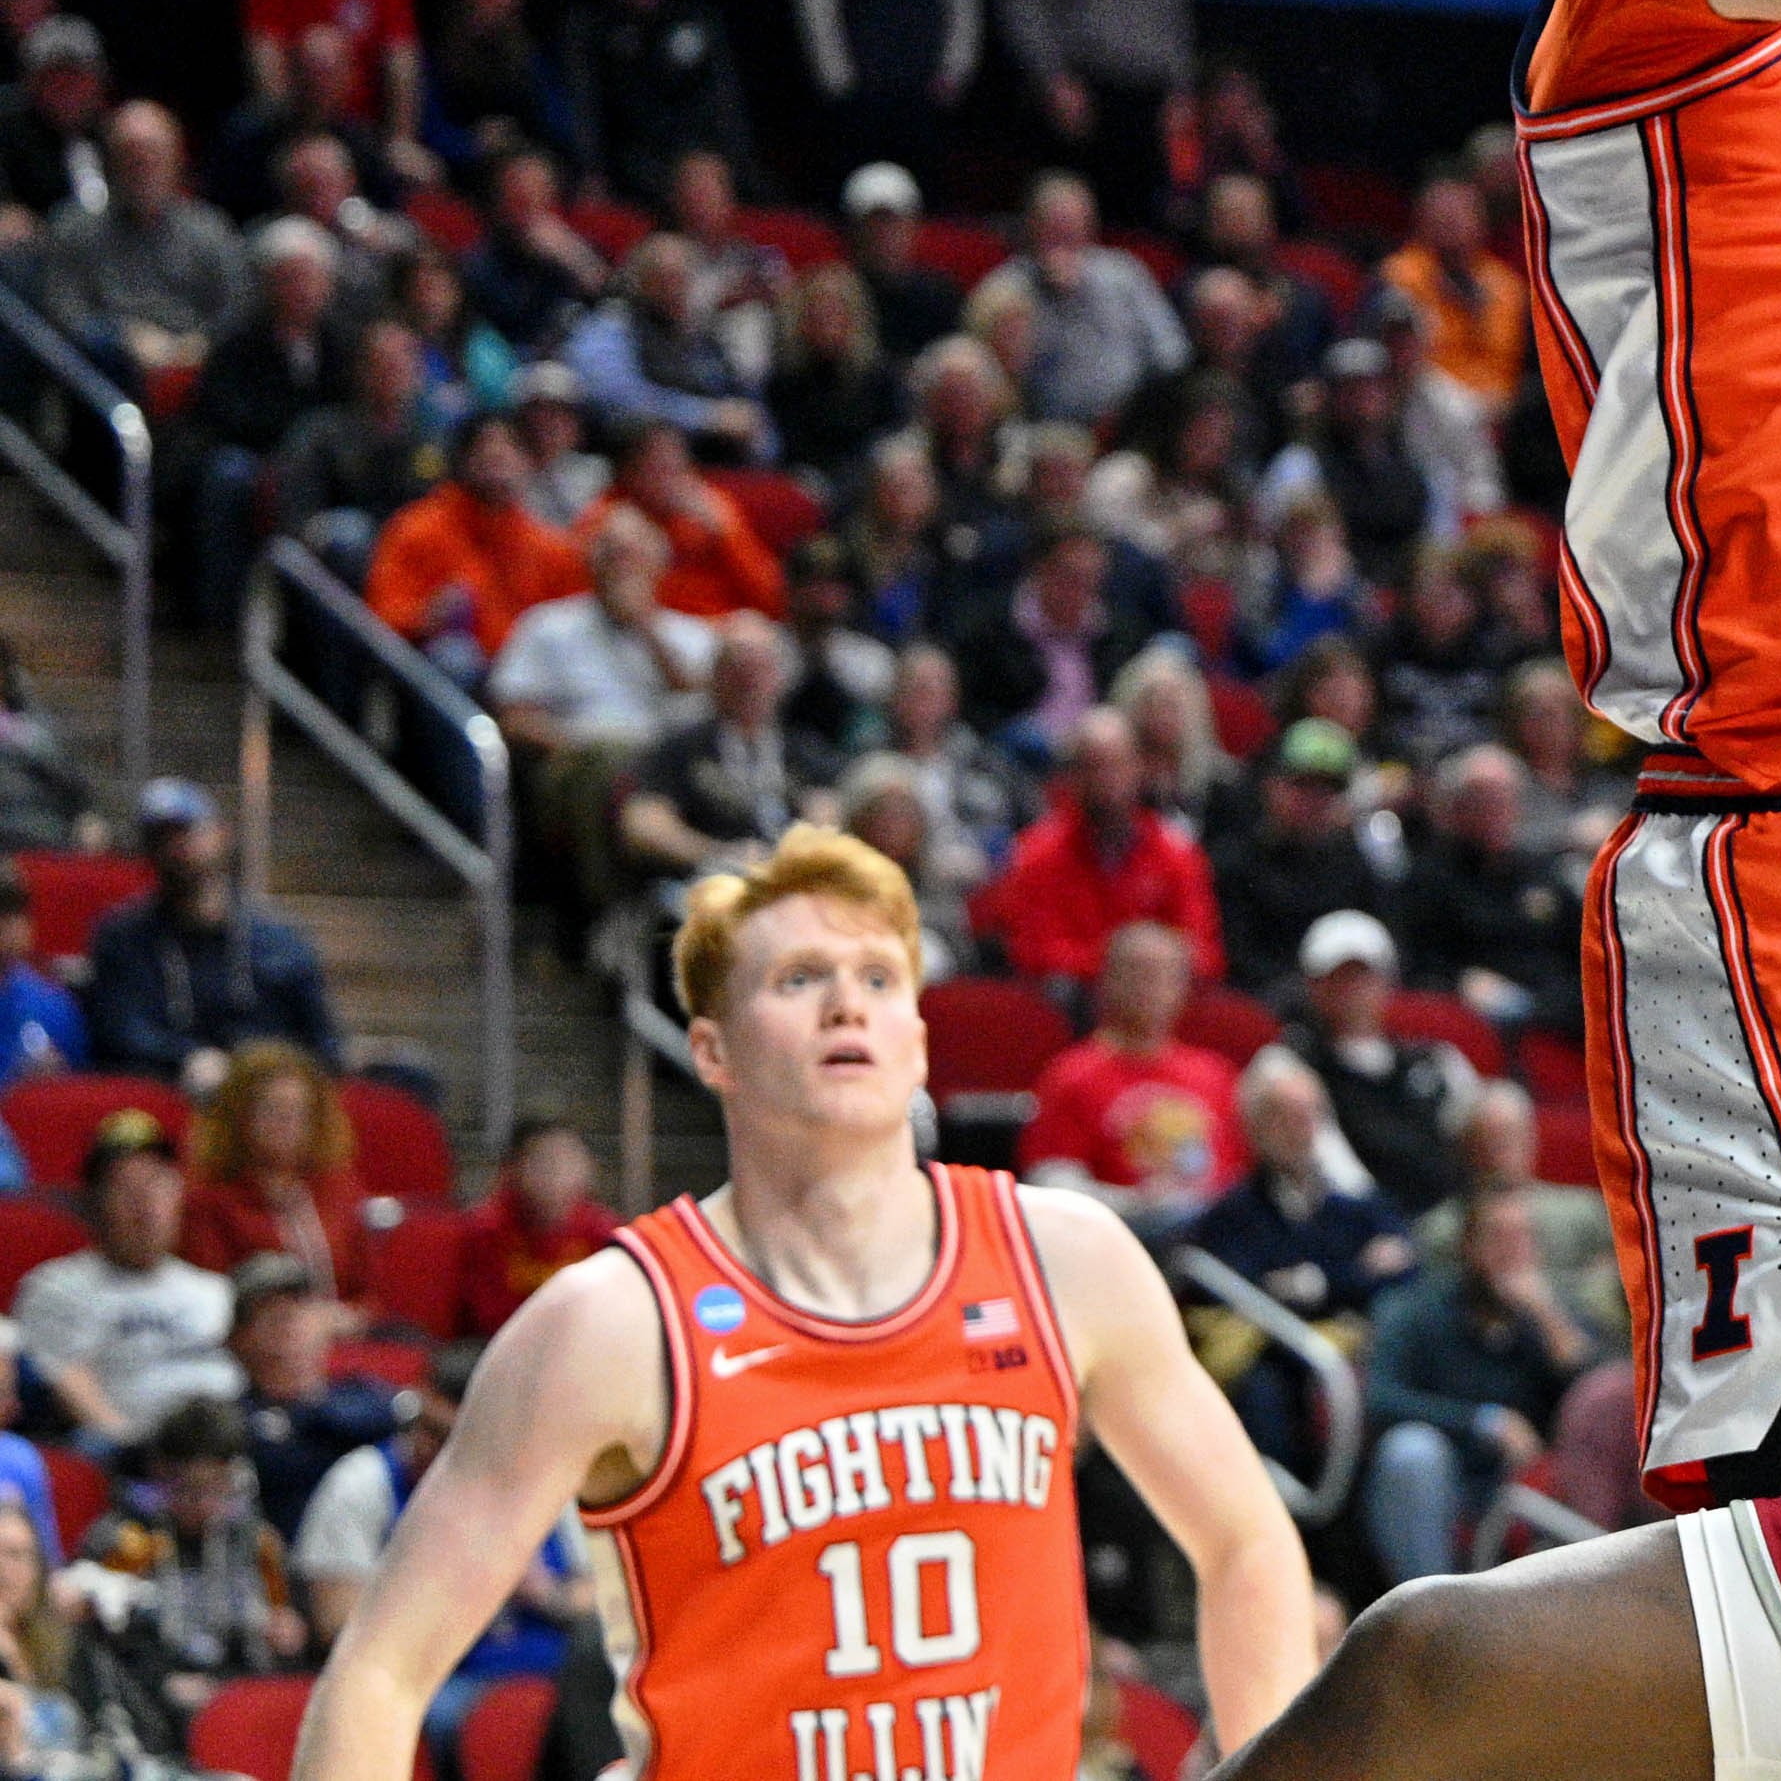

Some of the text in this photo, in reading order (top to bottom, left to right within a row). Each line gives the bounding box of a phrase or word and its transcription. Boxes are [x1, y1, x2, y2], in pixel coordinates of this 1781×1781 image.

[700, 1403, 1058, 1566] FIGHTING
[817, 1529, 982, 1679] 10
[789, 1685, 1000, 1781] ILLIN
